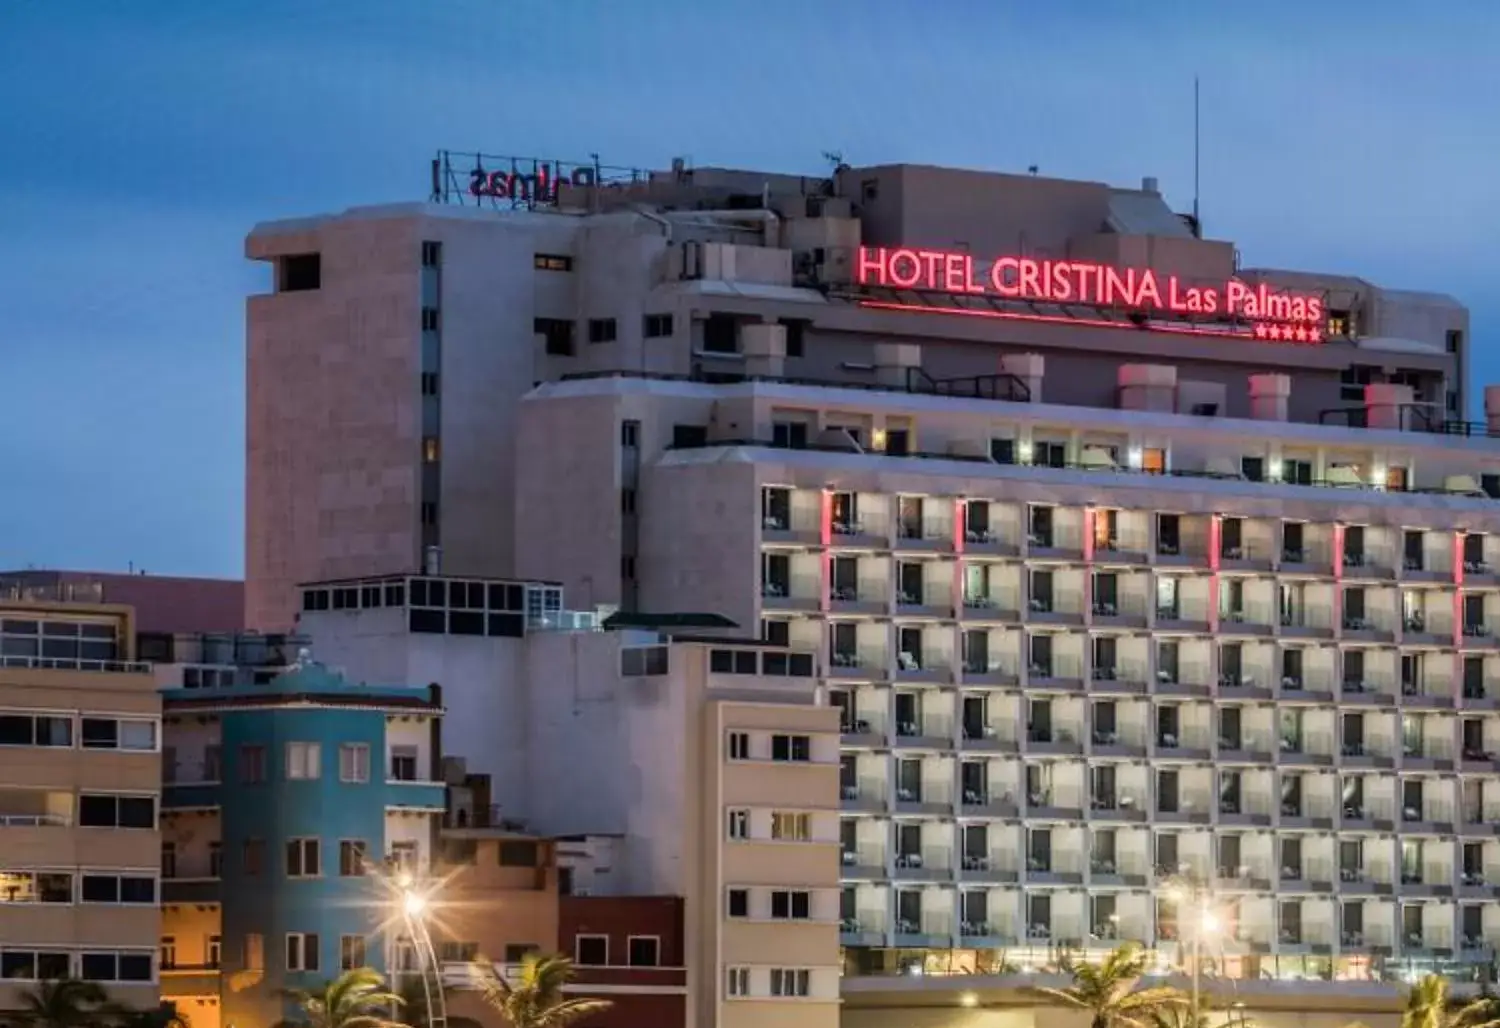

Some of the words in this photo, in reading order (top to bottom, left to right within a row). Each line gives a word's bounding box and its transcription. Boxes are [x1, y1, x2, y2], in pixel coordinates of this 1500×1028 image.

[859, 246, 985, 292] HOTEL
[992, 256, 1163, 309] CRISTINA
[1169, 275, 1217, 314] Las
[1226, 280, 1321, 321] Palmas
